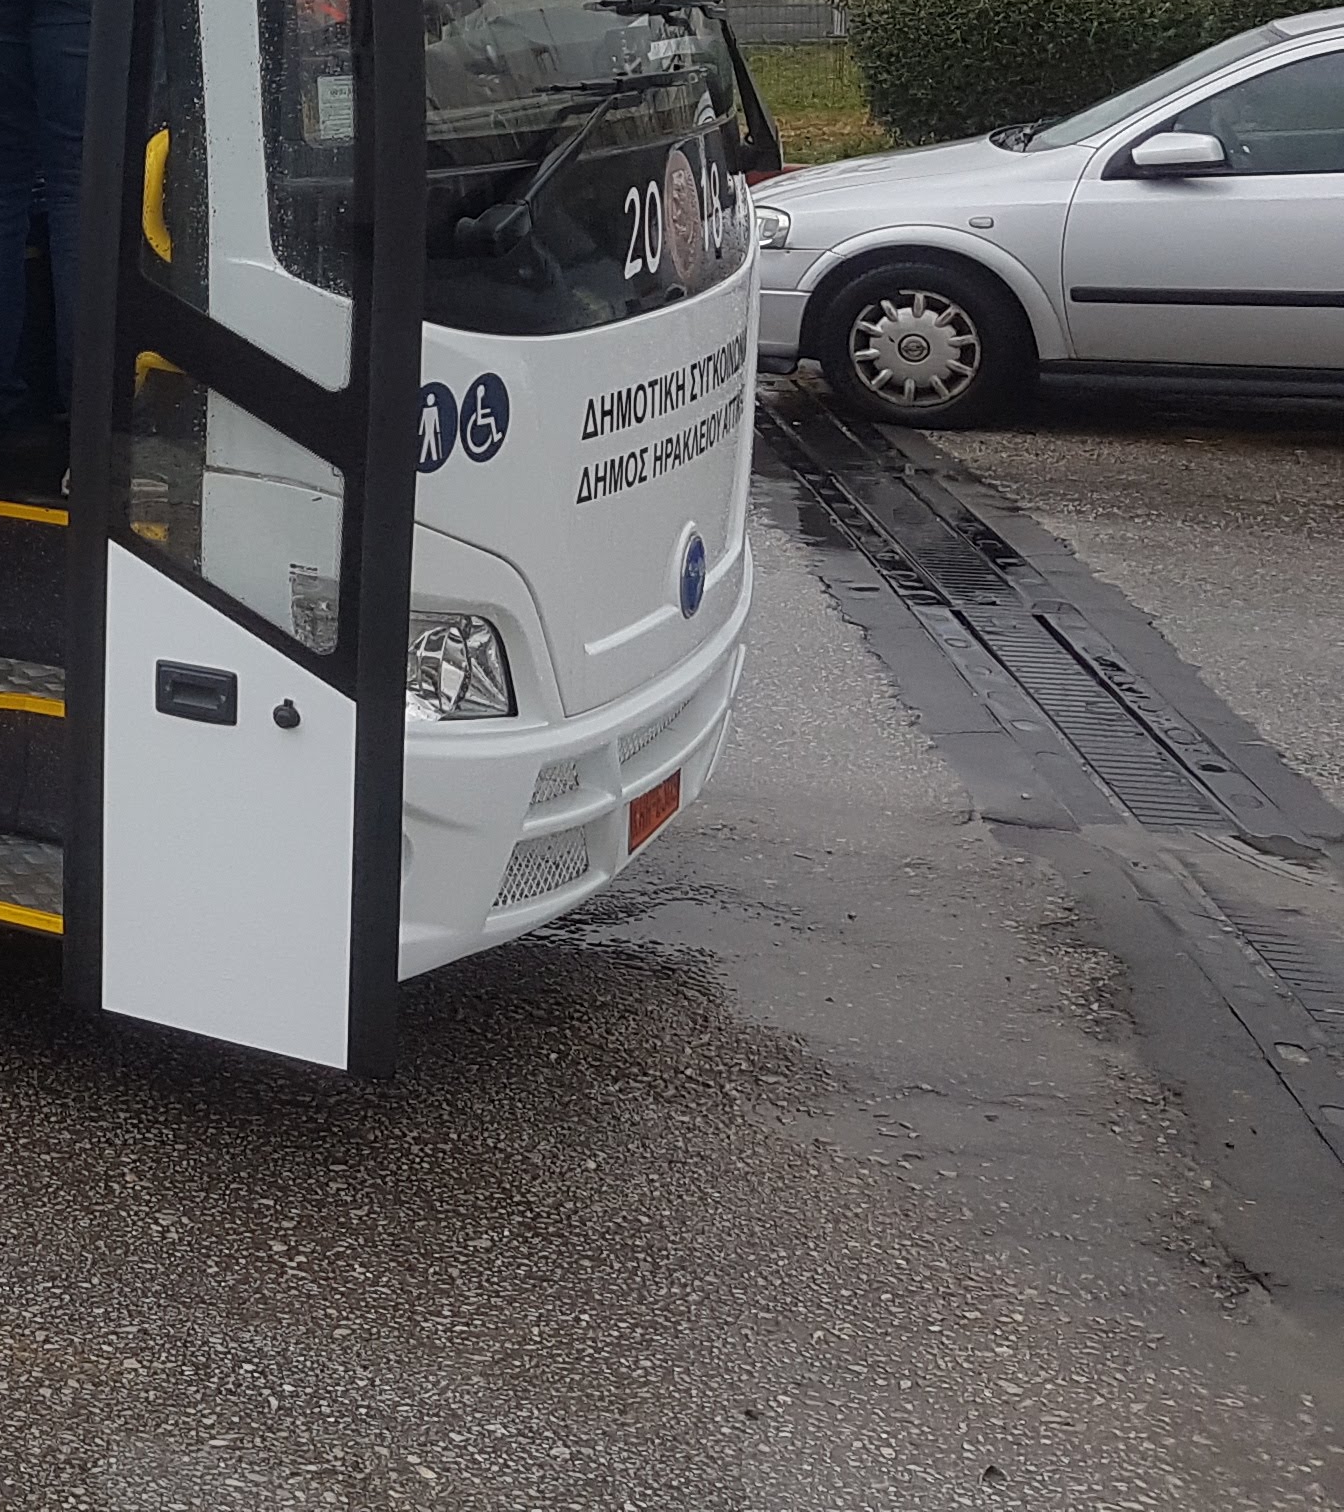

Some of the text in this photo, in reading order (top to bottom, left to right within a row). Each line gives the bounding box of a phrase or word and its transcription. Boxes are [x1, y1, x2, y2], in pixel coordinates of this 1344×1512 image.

[624, 180, 663, 280] 20
[581, 367, 686, 441] ΔΗΜΟΤΙΚΗ
[576, 446, 649, 505] ΔΗΜΟΣ
[652, 409, 723, 479] ΗΡΑΚΛΕΙΟΥ
